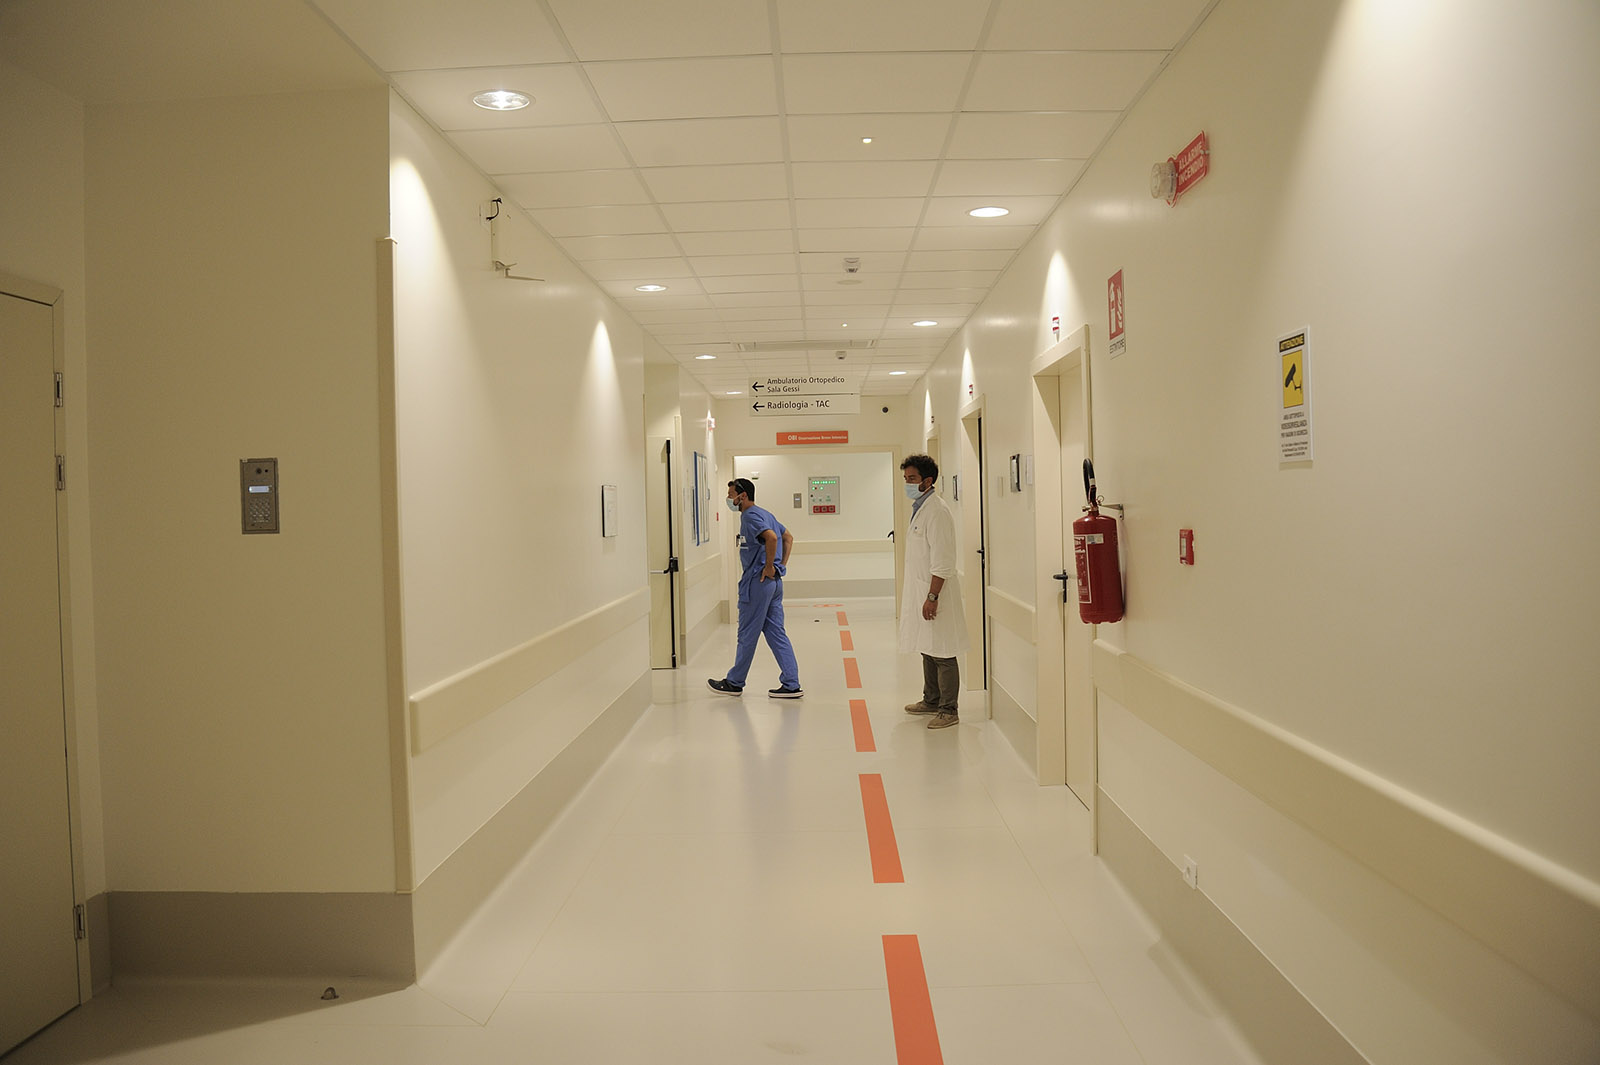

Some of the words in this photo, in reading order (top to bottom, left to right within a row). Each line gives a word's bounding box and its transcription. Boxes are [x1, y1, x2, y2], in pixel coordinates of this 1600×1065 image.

[1179, 140, 1202, 170] ALLARME
[1179, 155, 1204, 186] INCENDIO
[1281, 335, 1304, 350] ATTENZIONE
[767, 377, 807, 385] Ambulatorio
[808, 376, 845, 384] Ortopedico
[767, 400, 808, 410] Radiologia
